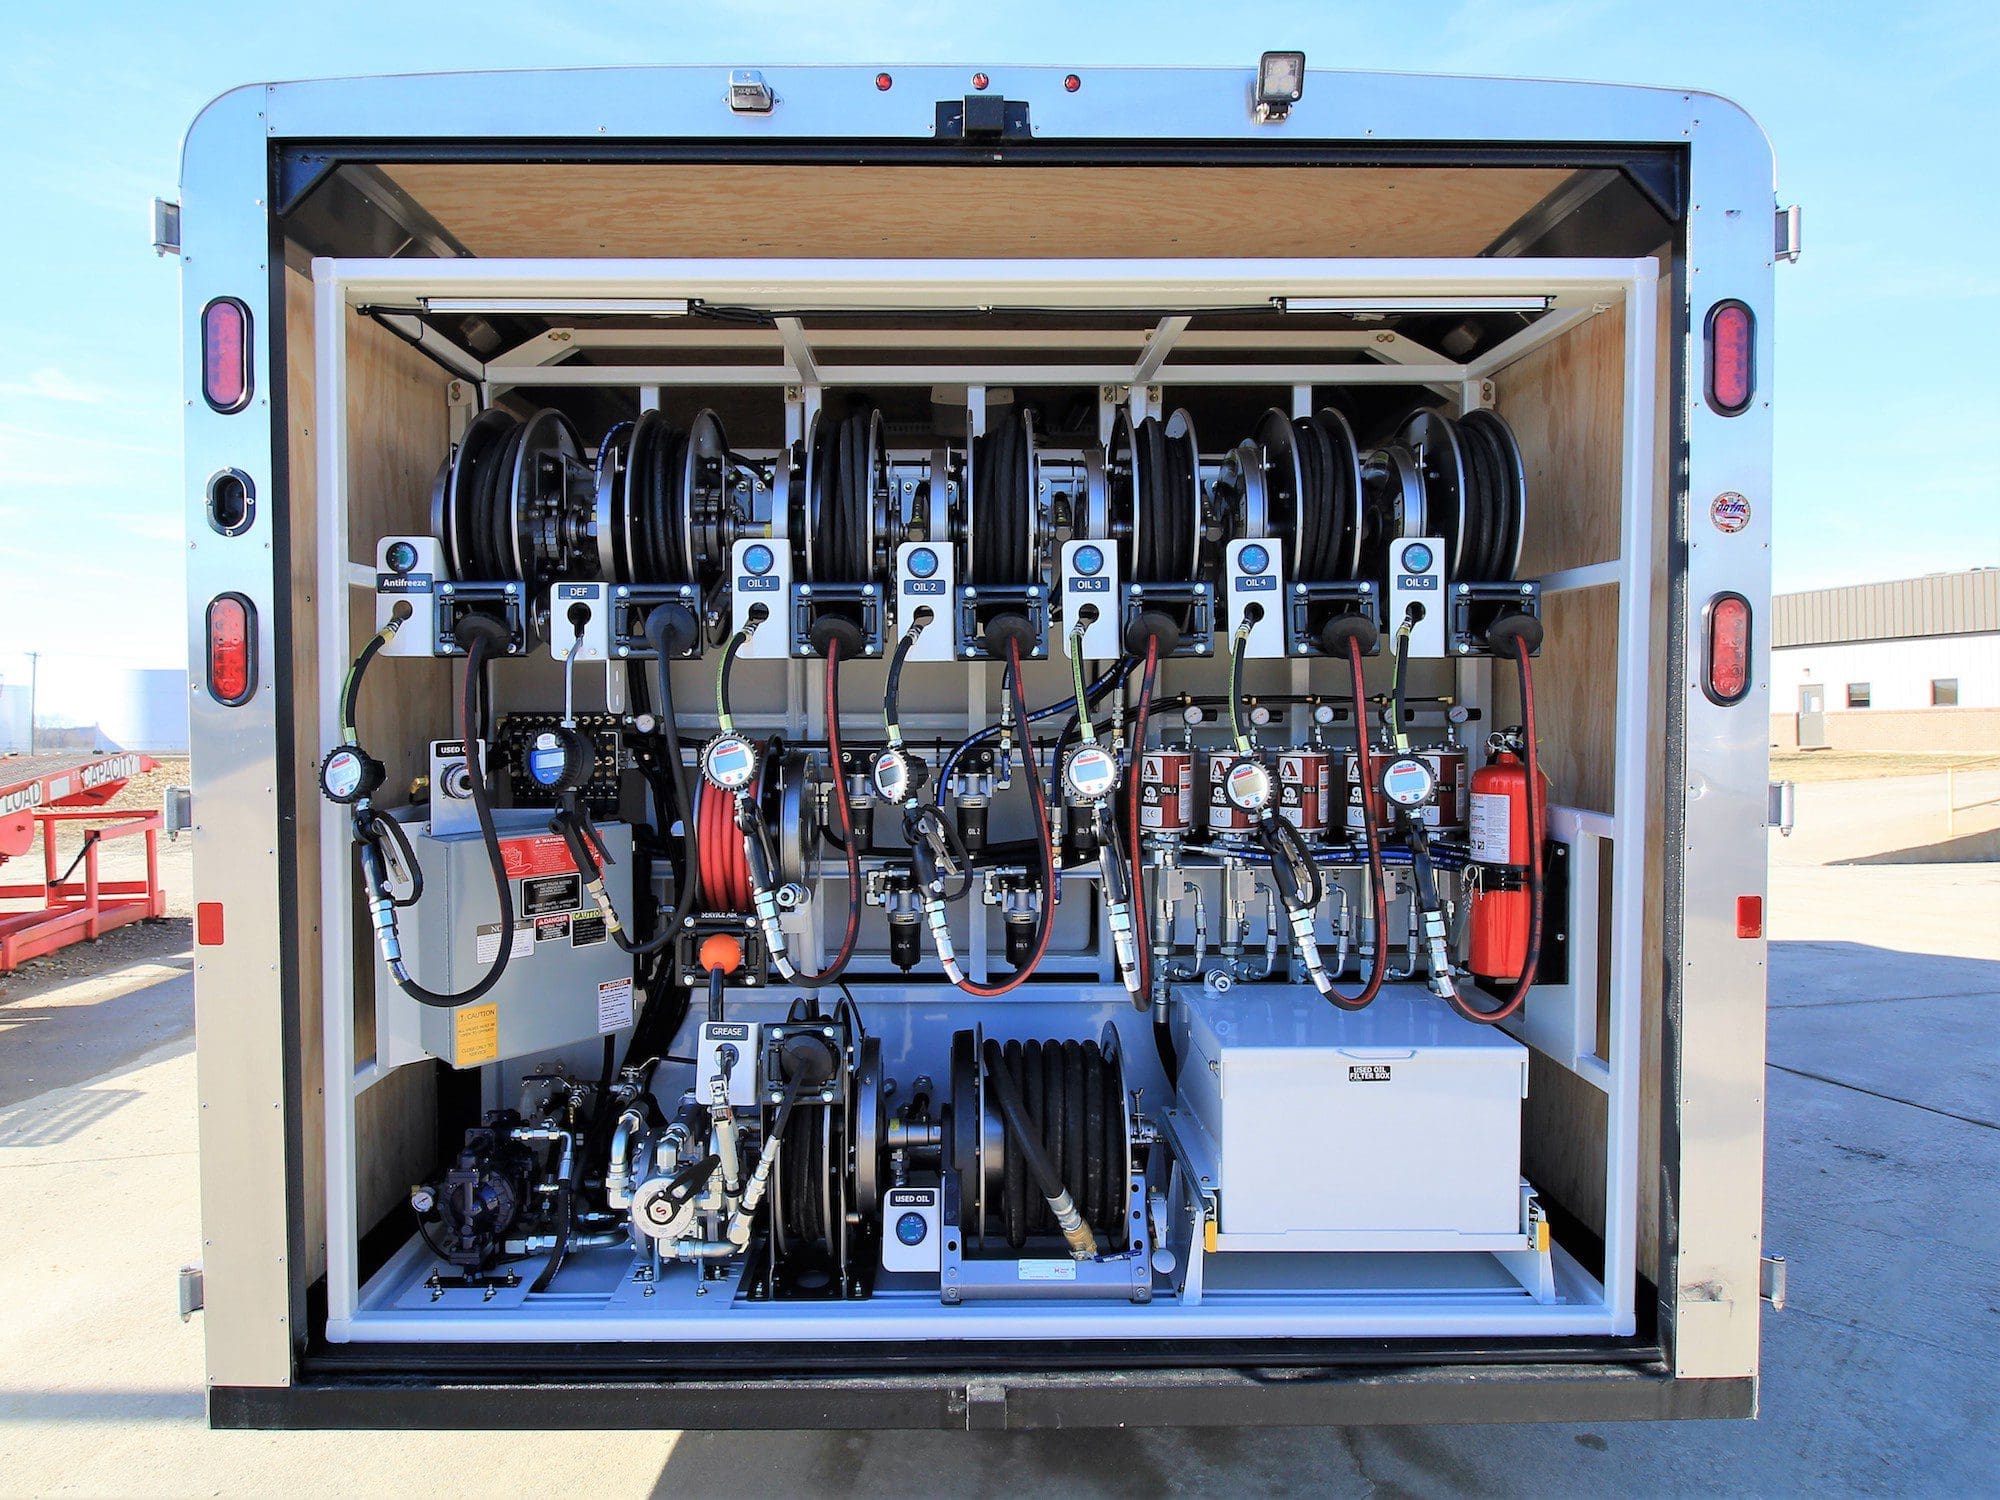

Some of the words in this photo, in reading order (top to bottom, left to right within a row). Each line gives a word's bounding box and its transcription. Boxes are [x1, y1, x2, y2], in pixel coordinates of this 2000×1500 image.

[383, 578, 427, 587] Antifreeze
[747, 579, 763, 588] OIL
[765, 579, 770, 588] 1
[912, 582, 928, 592] OIL
[930, 582, 937, 592] 2
[1077, 580, 1092, 589] OIL
[1094, 580, 1102, 589] 3
[1245, 578, 1260, 587] OIL
[1260, 578, 1267, 587] 4
[1405, 578, 1421, 587] OIL
[1422, 578, 1430, 587] 5
[570, 587, 588, 596] DEF
[440, 746, 460, 754] USED
[5, 782, 42, 812] LOAD
[82, 755, 136, 789] CAPACITY
[574, 909, 601, 919] CAUTIO
[543, 915, 568, 924] DANGER
[467, 1009, 496, 1020] CAUTION
[712, 1027, 743, 1036] GREASE
[1350, 1072, 1374, 1080] FILTER
[1375, 1072, 1390, 1080] BOX
[895, 1195, 915, 1203] USED
[915, 1195, 930, 1203] OIL
